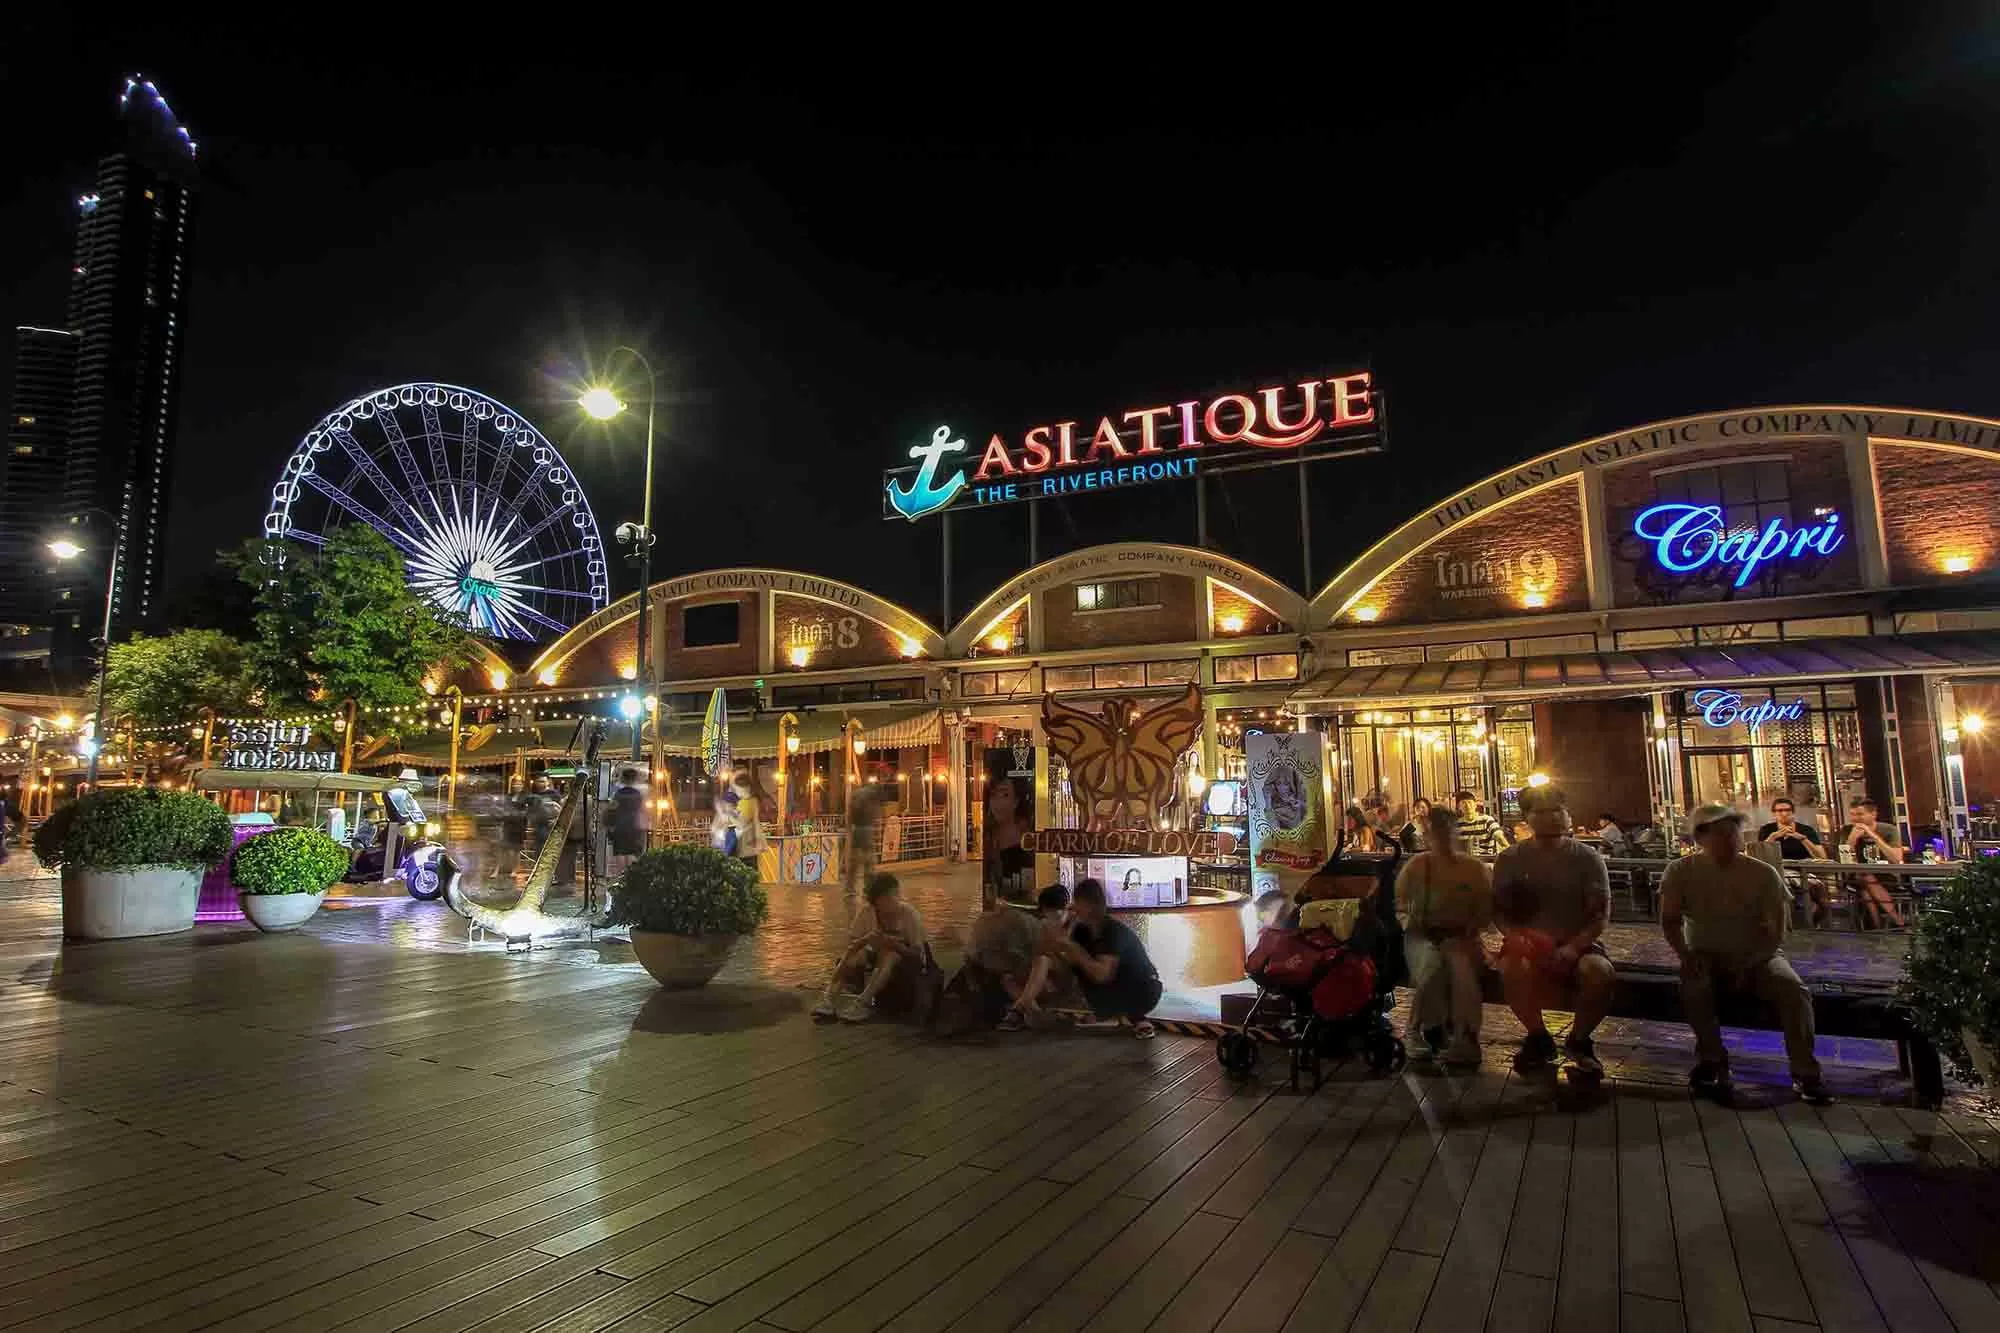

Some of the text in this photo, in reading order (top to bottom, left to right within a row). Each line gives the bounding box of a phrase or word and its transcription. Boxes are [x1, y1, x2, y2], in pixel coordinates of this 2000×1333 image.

[974, 371, 1374, 481] ASIATIQUE
[975, 457, 1198, 503] THE RIVERFRONT
[1432, 492, 1483, 529] THE
[1493, 458, 1561, 498] EAST
[1578, 423, 1700, 466] ASIATIC
[1718, 412, 1884, 438] COMPANY
[1118, 551, 1184, 563] COMPANY
[1190, 559, 1242, 581] LIMITED
[1633, 503, 1846, 587] Capri
[648, 579, 697, 603] ASIATIC
[706, 573, 776, 588] COMPANY
[788, 577, 862, 607] LIMITED
[1519, 548, 1558, 593] 9
[838, 616, 860, 649] 8
[1694, 688, 1804, 733] Capri
[1020, 832, 1099, 853] CHARM
[1103, 831, 1141, 853] OF
